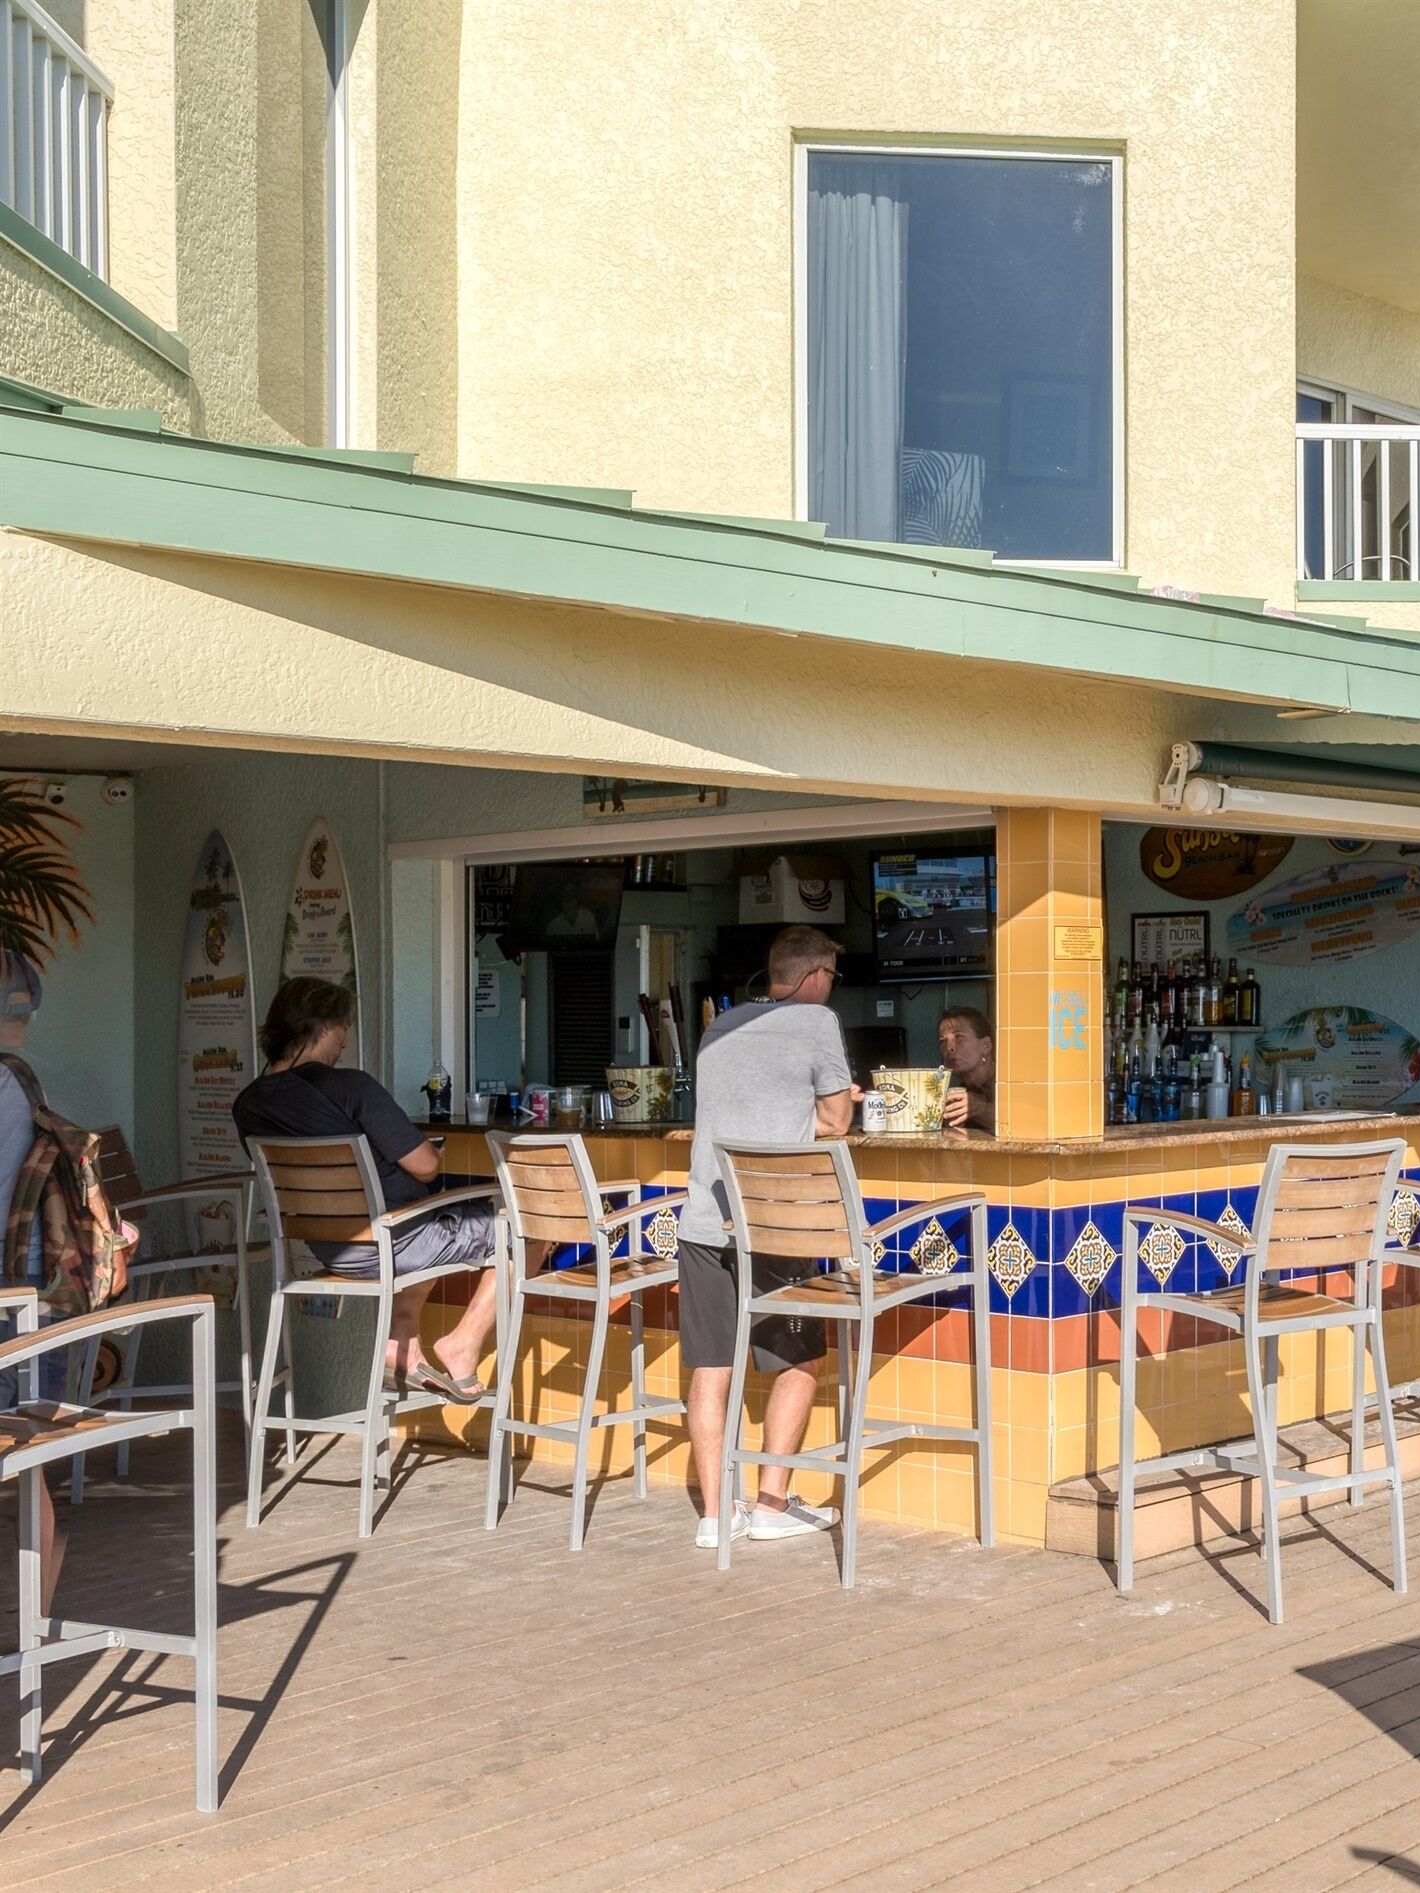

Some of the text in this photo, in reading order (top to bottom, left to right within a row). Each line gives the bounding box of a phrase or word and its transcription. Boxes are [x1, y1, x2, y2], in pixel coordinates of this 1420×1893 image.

[880, 854, 916, 863] SUNOCO
[324, 888, 342, 899] MENU
[1272, 906, 1310, 921] SPECIALTY
[1313, 899, 1340, 911] DRINKS
[1342, 896, 1353, 906] ON
[1354, 892, 1368, 902] THE
[1049, 1006, 1088, 1050] ICE
